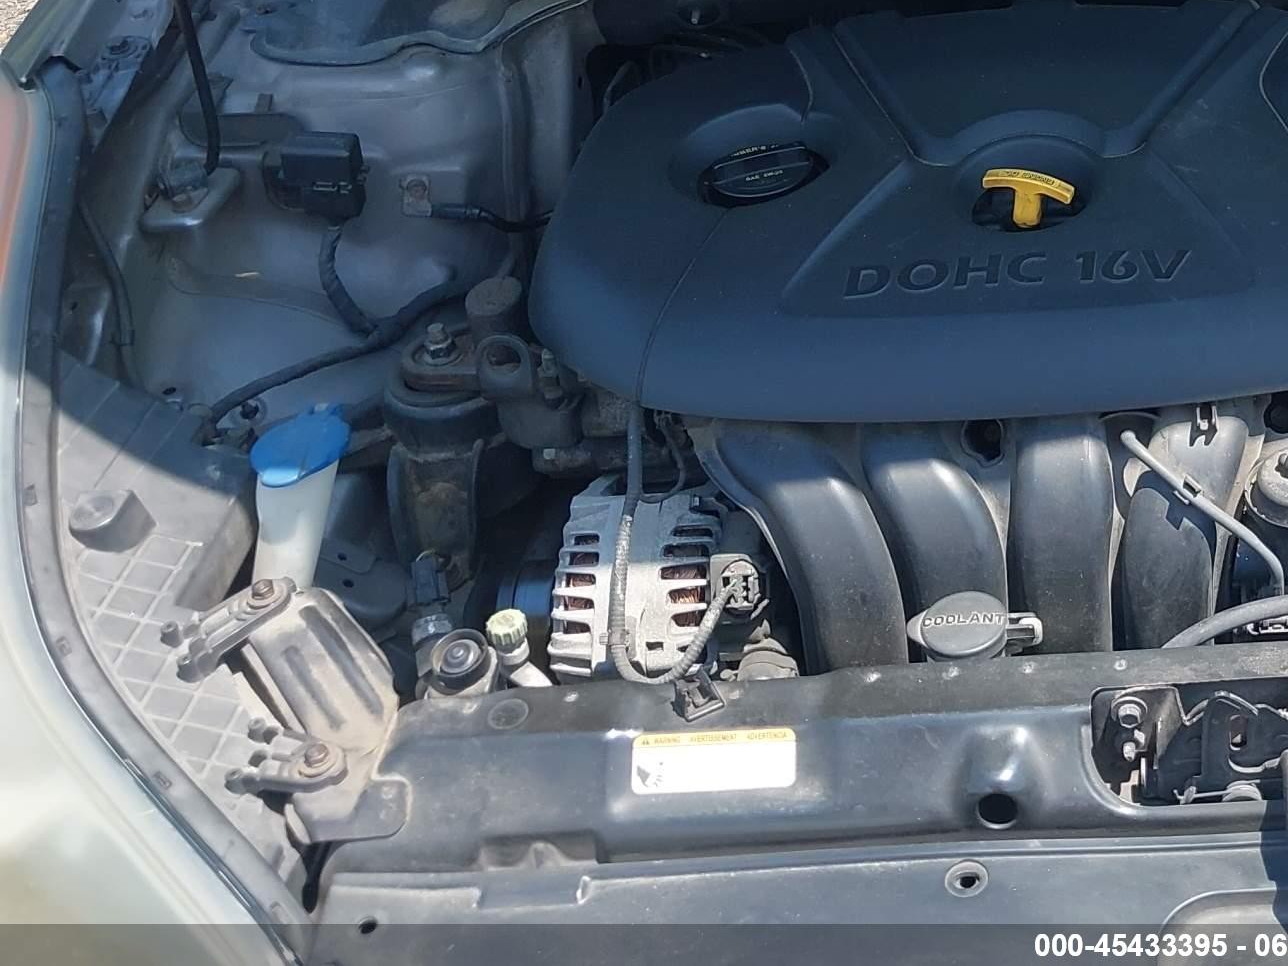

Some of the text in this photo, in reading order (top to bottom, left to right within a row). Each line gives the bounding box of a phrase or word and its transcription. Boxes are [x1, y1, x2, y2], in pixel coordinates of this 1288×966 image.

[843, 249, 1192, 299] DOHC 16V
[921, 612, 1006, 628] COOLANT
